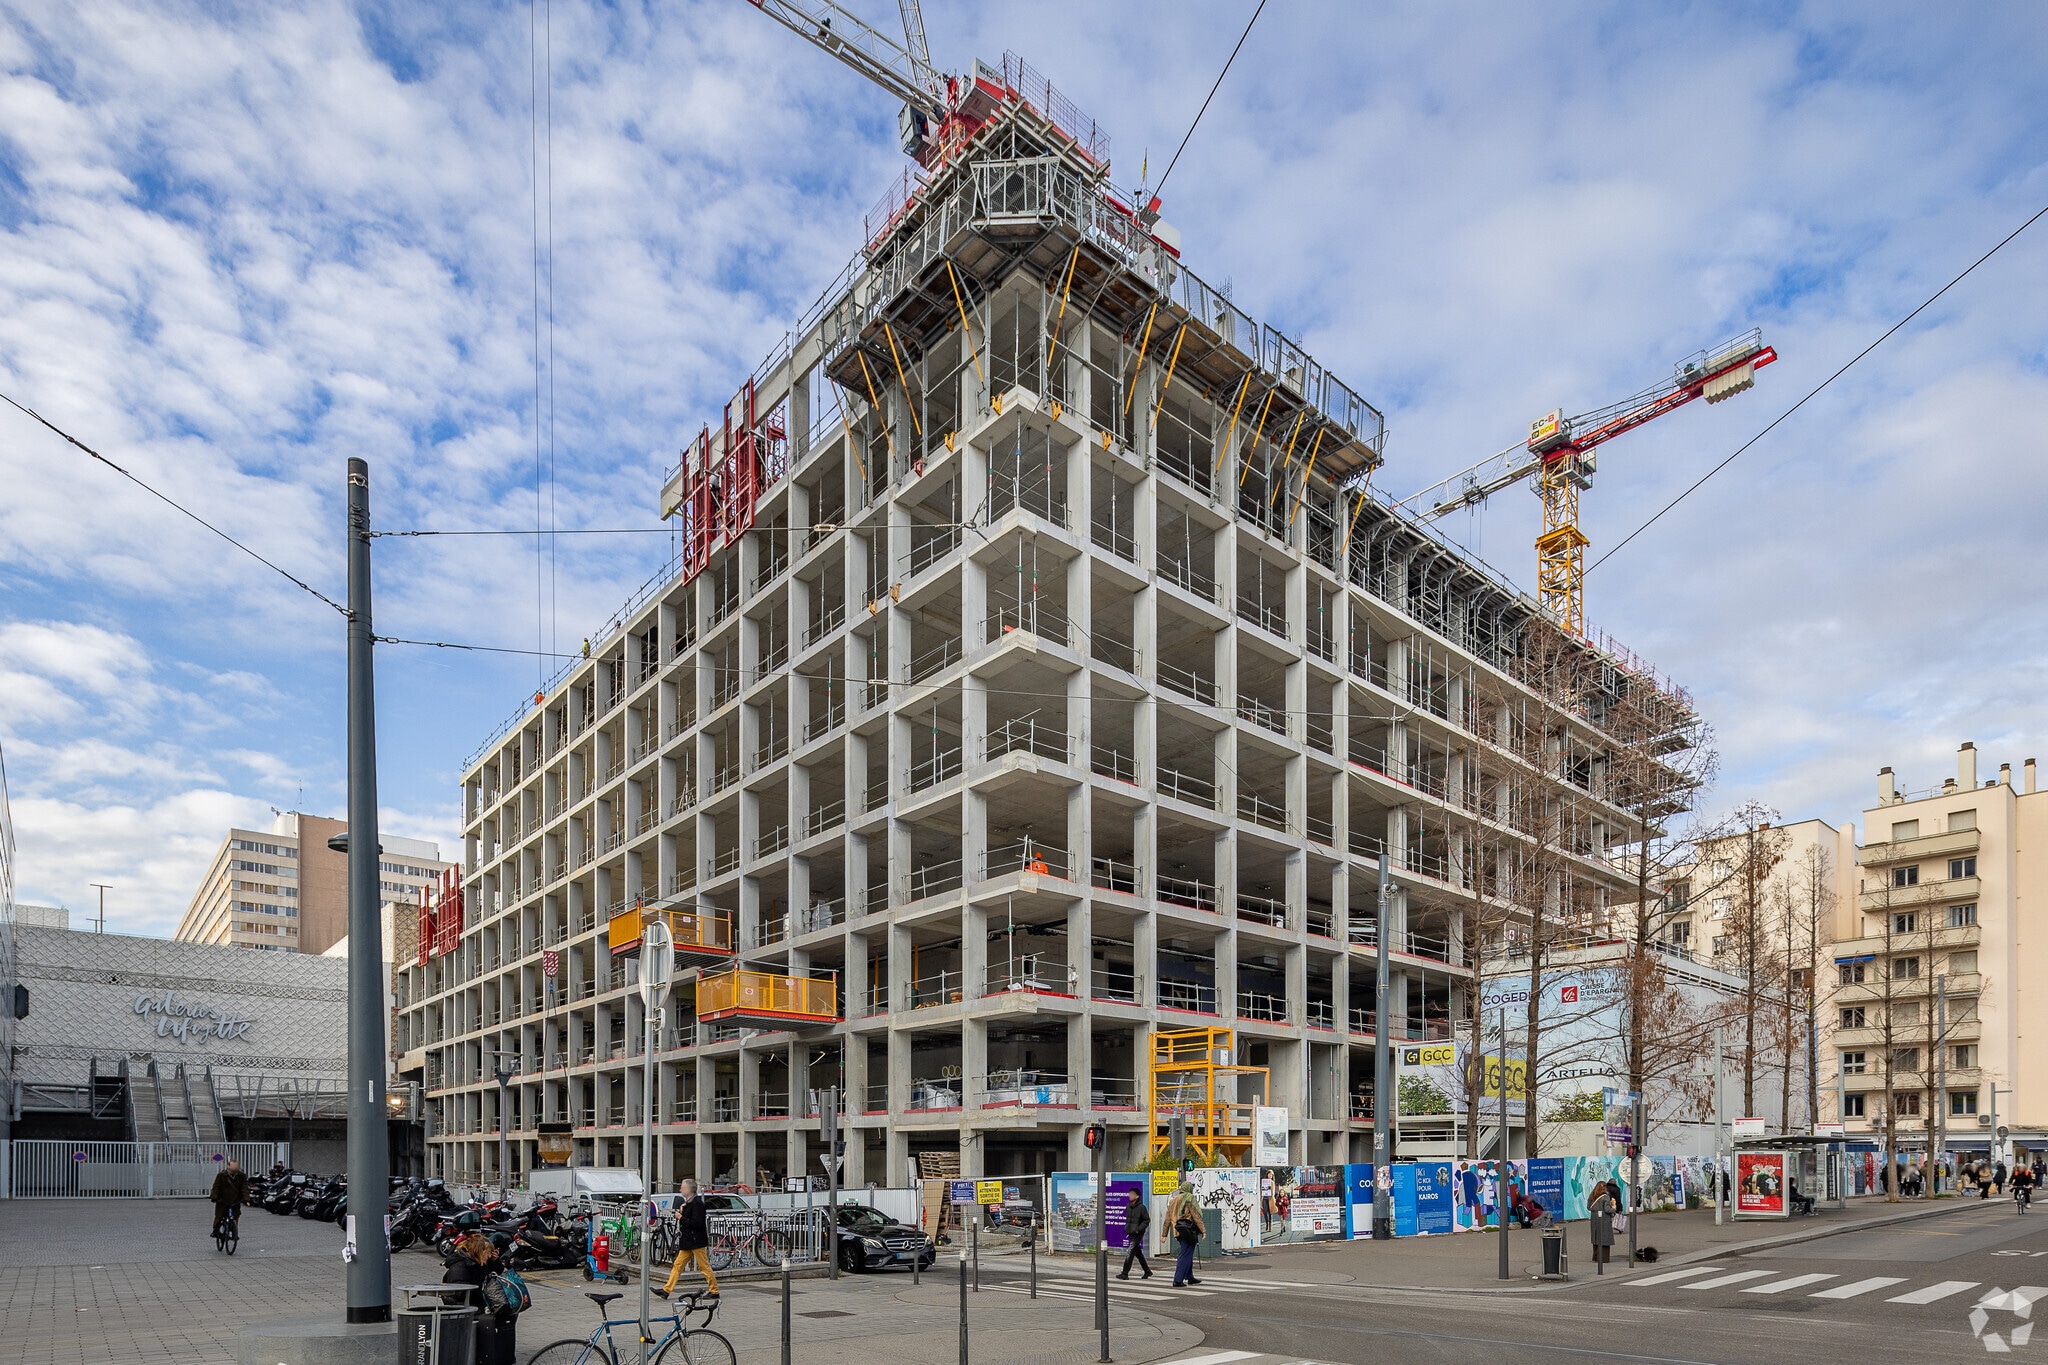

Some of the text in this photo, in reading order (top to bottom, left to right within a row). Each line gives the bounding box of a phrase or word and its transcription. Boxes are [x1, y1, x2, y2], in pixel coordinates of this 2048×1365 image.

[1532, 413, 1555, 431] EC-B
[135, 989, 218, 1020] Galeries
[157, 1012, 257, 1045] Lafayette
[1423, 1049, 1451, 1062] GCC
